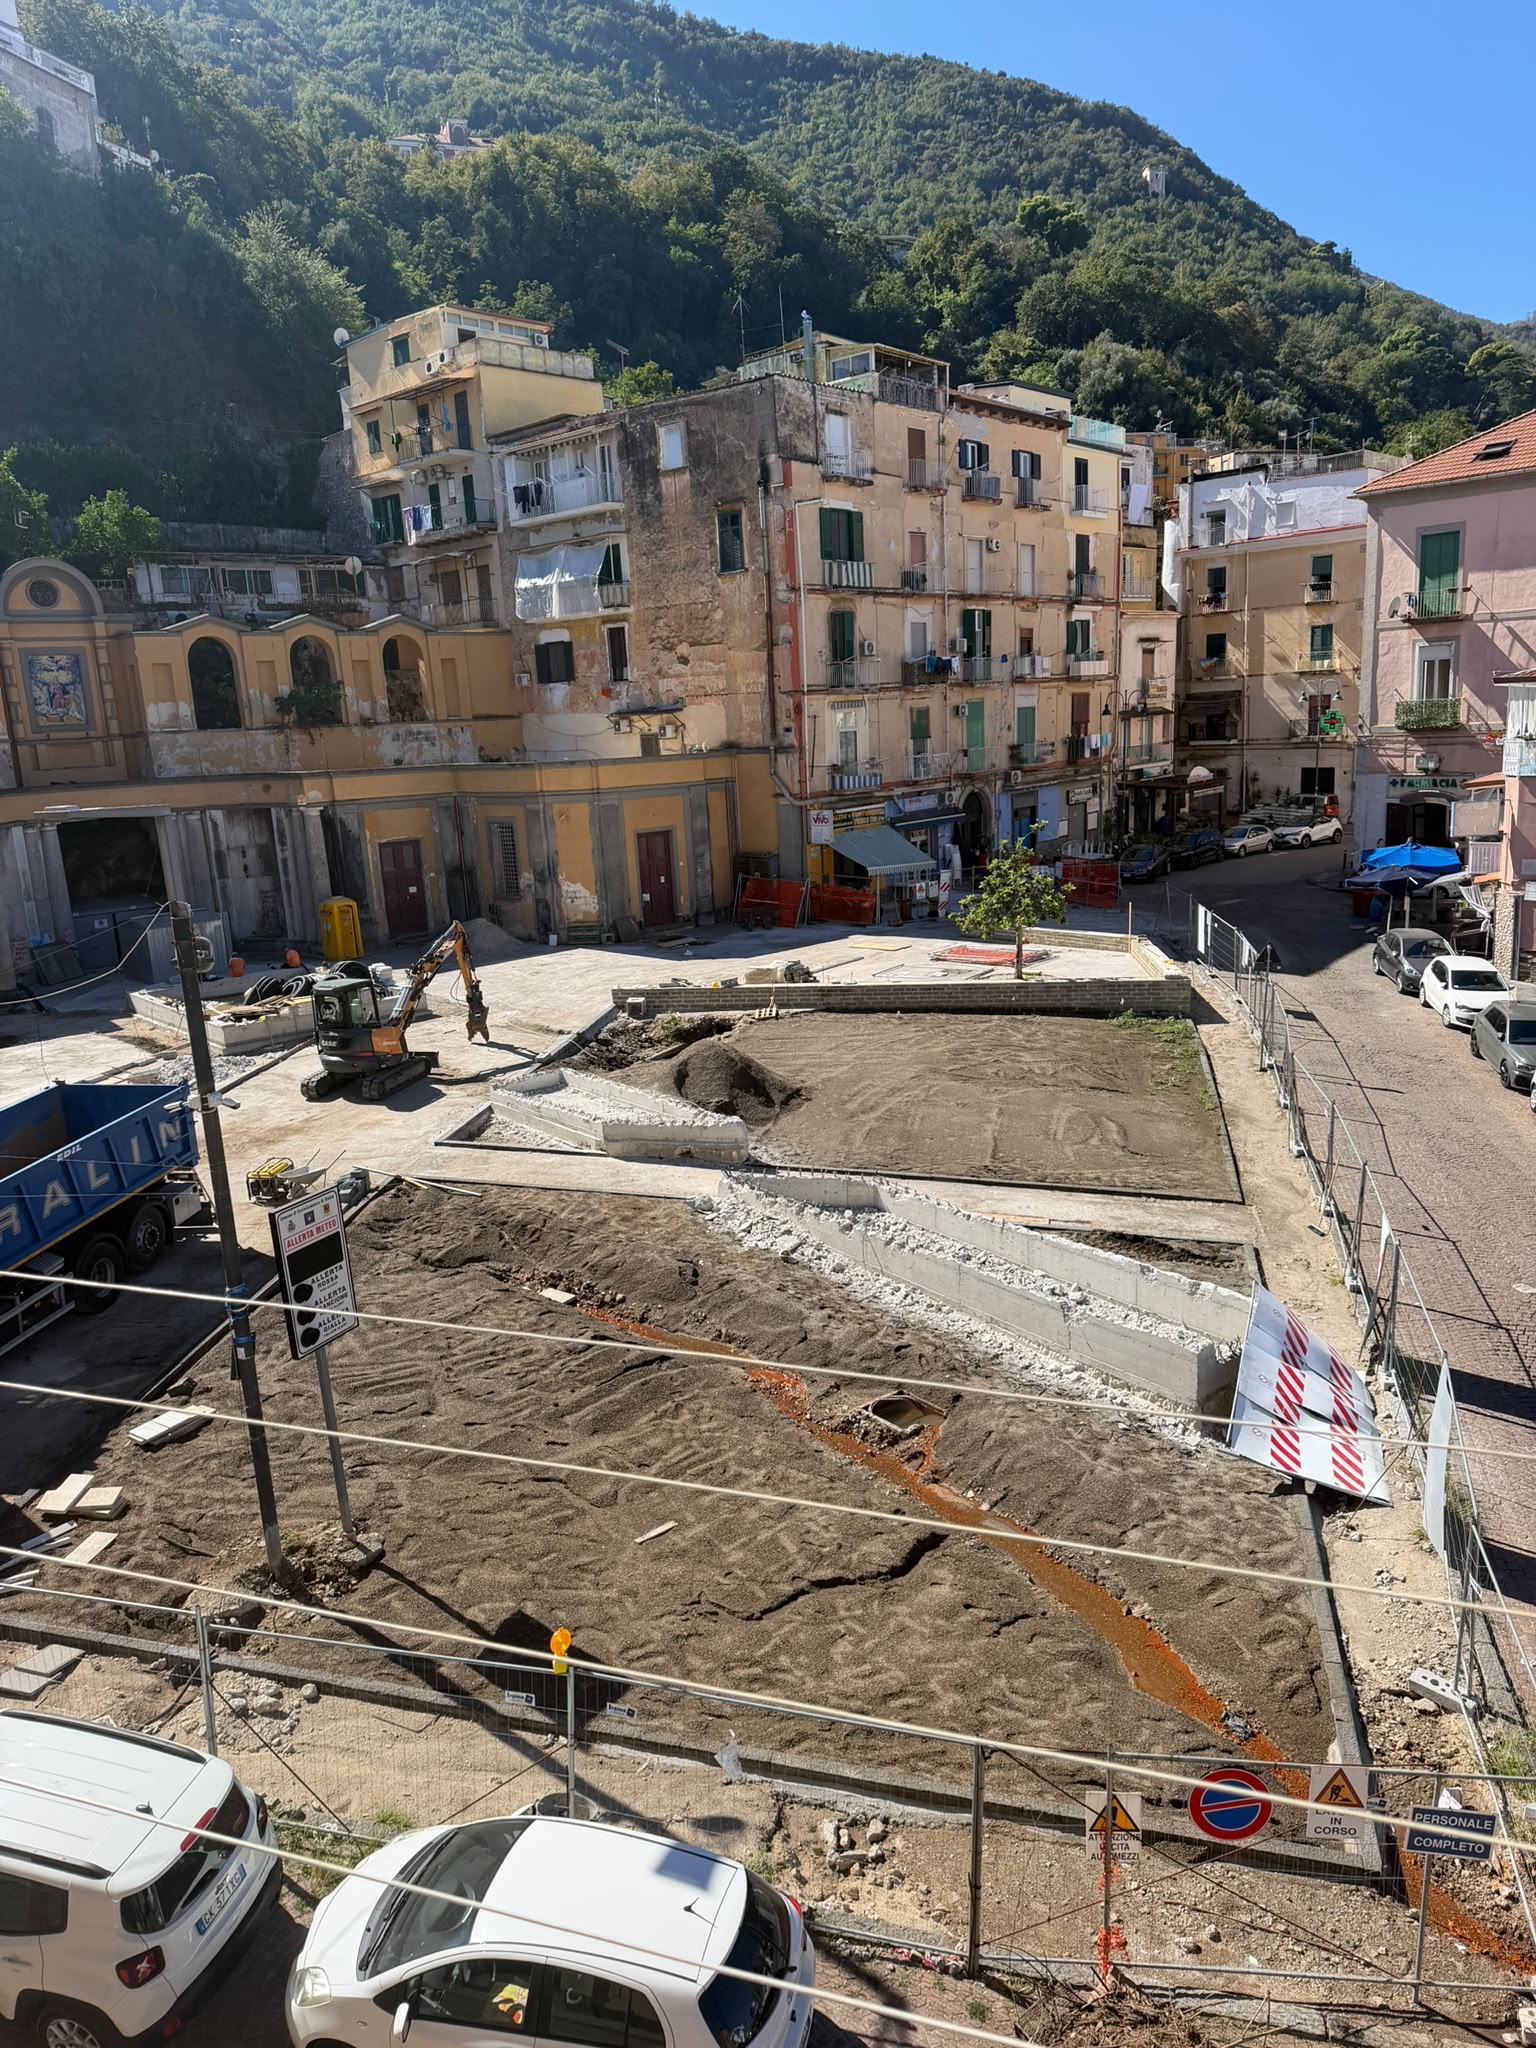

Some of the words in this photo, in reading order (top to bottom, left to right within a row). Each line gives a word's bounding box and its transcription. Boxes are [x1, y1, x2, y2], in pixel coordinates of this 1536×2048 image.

[1400, 778, 1457, 788] FARMACIA
[56, 1144, 82, 1162] EDIL
[287, 1230, 314, 1249] ALLERTA
[315, 1218, 337, 1236] METEO
[311, 1263, 344, 1285] ALLERTA
[317, 1274, 339, 1289] ROSSA
[314, 1285, 347, 1307] ALLERTA
[323, 1316, 347, 1333] GIALLA
[1330, 1817, 1342, 1825] IN
[1414, 1812, 1493, 1831] PERSONALE
[1088, 1833, 1140, 1841] ATTNZIONE
[1314, 1826, 1357, 1836] CORSO
[1100, 1842, 1130, 1851] UCITA
[1413, 1836, 1485, 1854] COMPLETO
